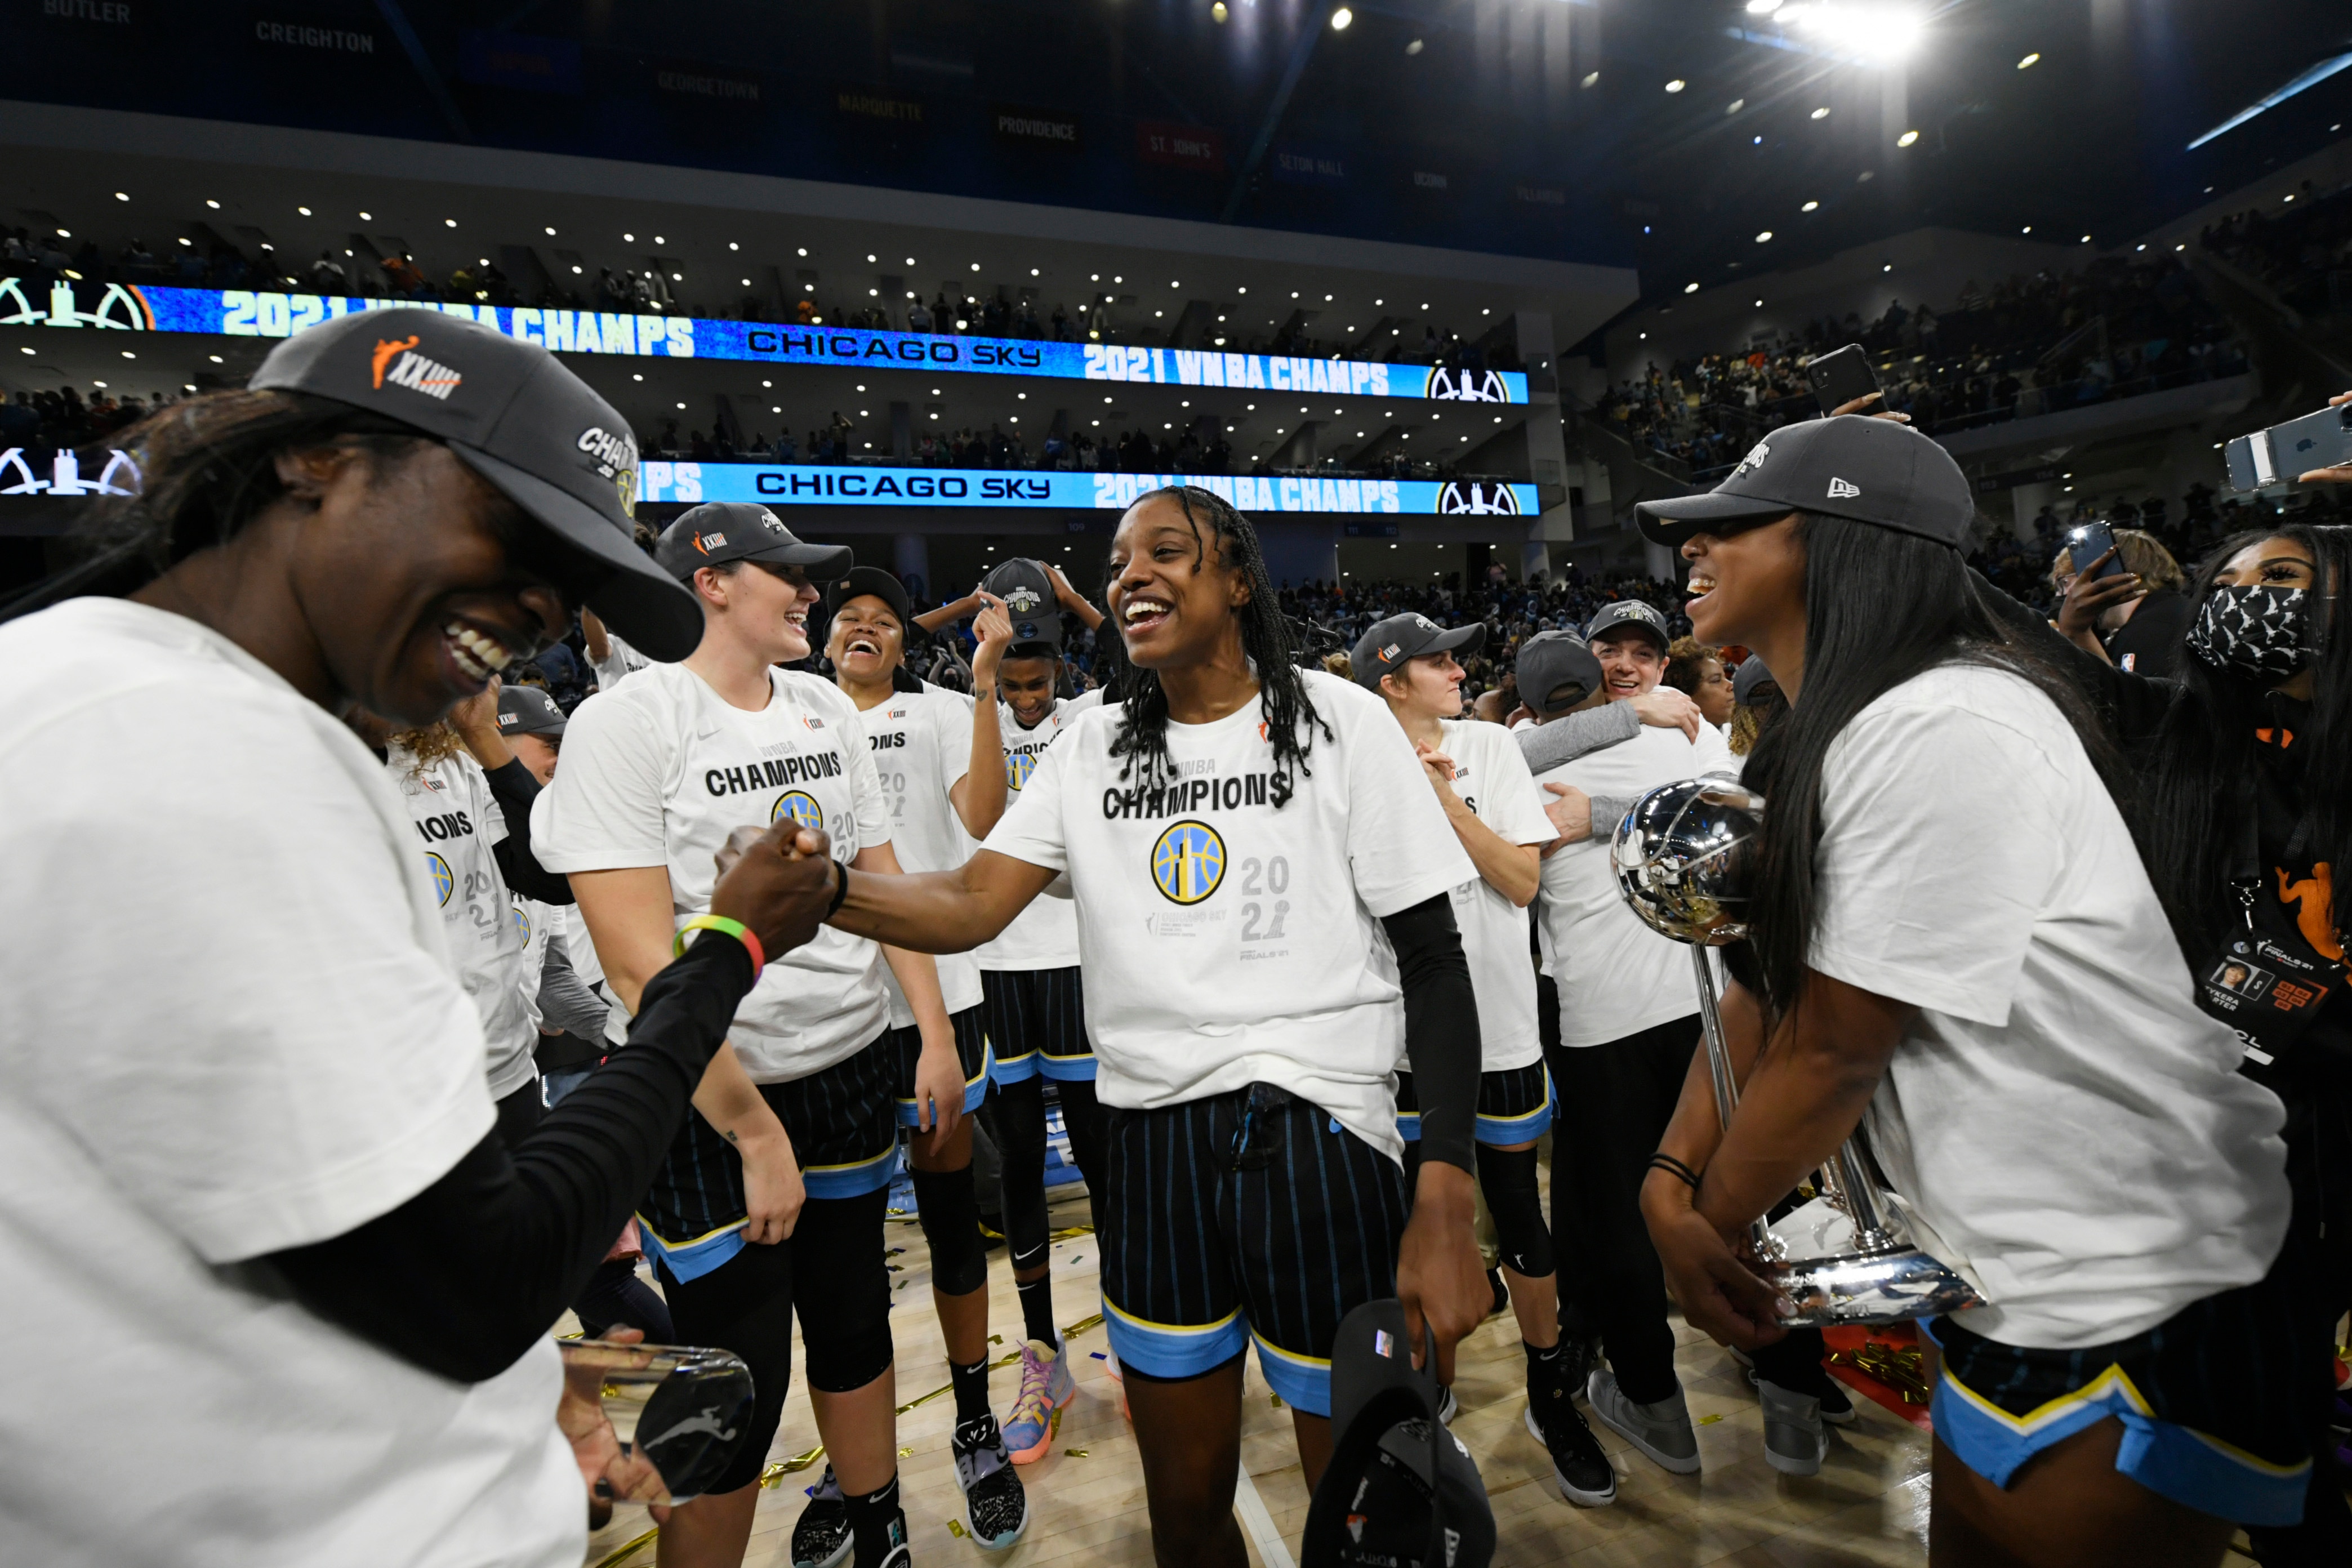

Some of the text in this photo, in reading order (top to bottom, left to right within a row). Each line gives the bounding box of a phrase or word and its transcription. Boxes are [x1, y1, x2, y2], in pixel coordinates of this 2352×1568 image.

[44, 0, 130, 24] BUTLER
[256, 21, 374, 54] CREIGHTON
[658, 70, 758, 100] GEORGETOWN
[838, 93, 923, 122] MARQUETTE
[997, 115, 1076, 141] PROVIDENCE
[1279, 153, 1343, 177] SETON HALL
[513, 308, 694, 358] CHAMPS
[747, 331, 1041, 368] CHICAGO SKY
[1084, 344, 1389, 396] 2021 WNBA CHAMPS
[755, 473, 1051, 500] CHICAGO SKY
[1279, 477, 1400, 513] CHAMPS
[1068, 523, 1085, 532] 109
[1004, 591, 1041, 604] CHAMPIONS
[758, 741, 798, 757] WNBA
[1011, 733, 1034, 746] WNBA
[705, 751, 841, 797] CHAMPIONS
[1103, 772, 1289, 819] CHAMPIONS
[832, 812, 854, 842] 20
[464, 870, 492, 902] 20
[1241, 855, 1289, 897] 20
[1161, 909, 1227, 923] CHICAGO SKY
[1240, 951, 1276, 961] FINALS
[2265, 947, 2301, 965] FINALS
